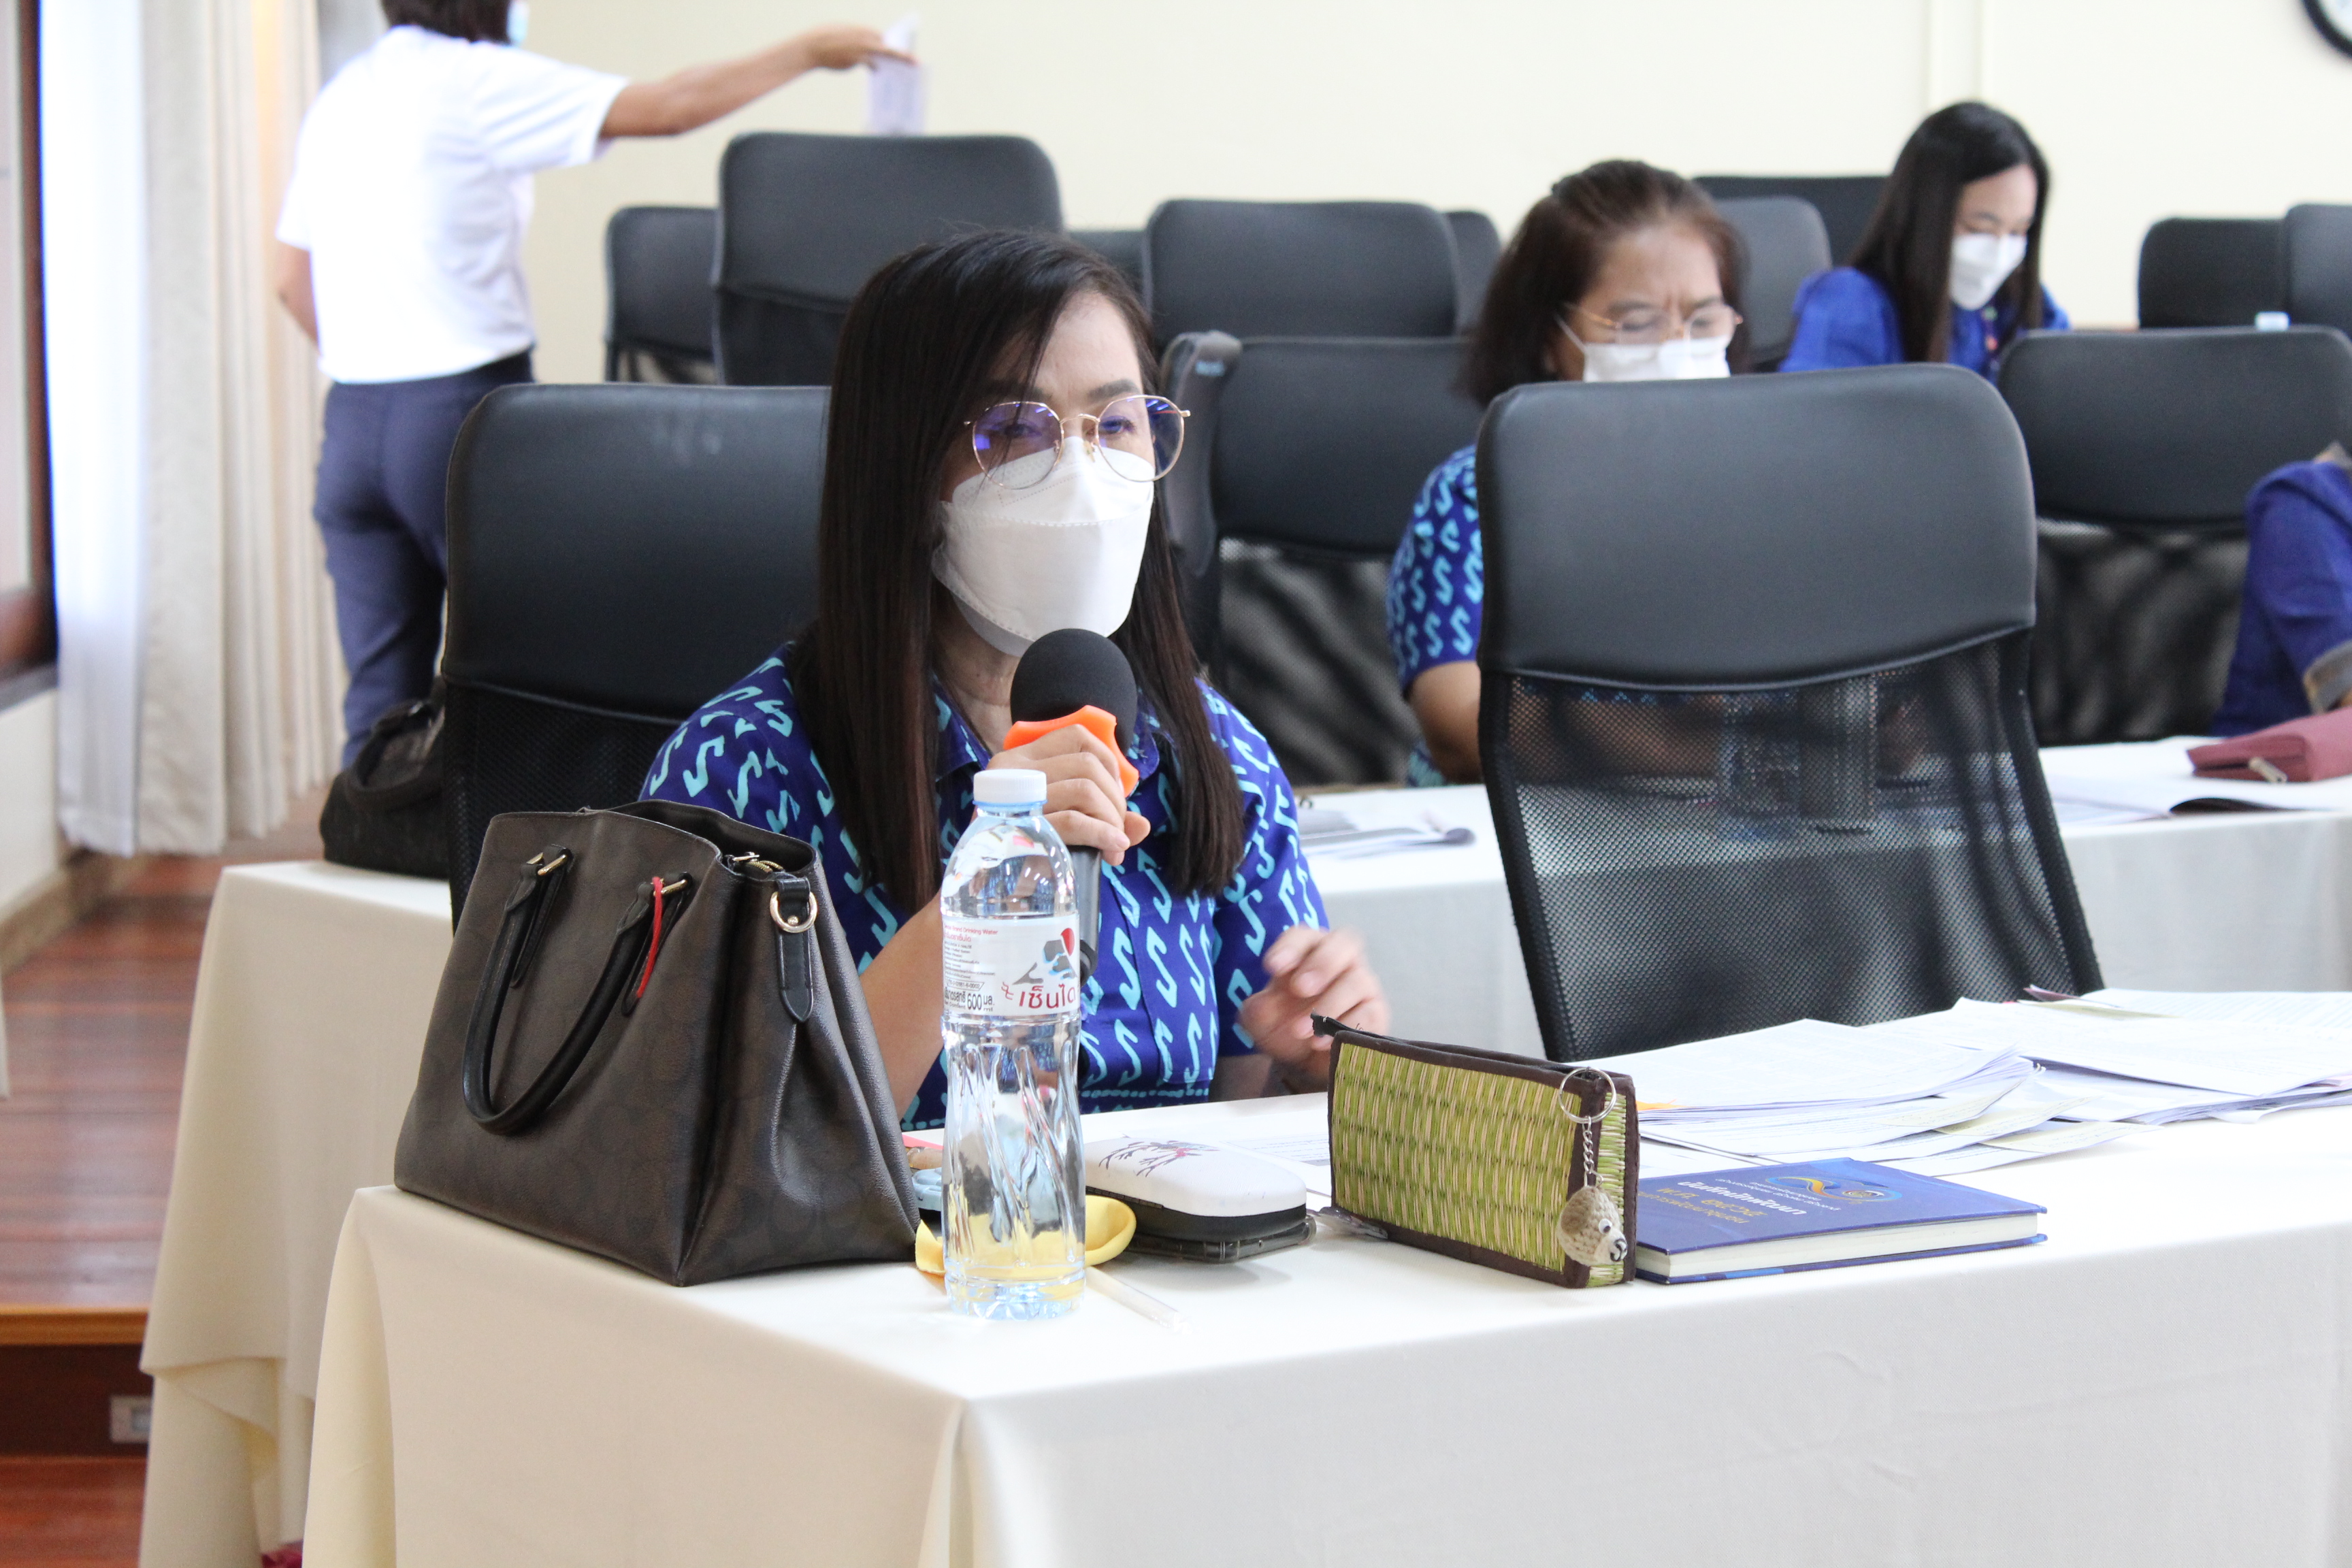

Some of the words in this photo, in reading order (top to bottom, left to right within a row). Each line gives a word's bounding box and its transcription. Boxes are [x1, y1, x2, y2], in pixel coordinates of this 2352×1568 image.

[963, 928, 981, 936] Drinking
[967, 993, 982, 1011] 600
[1678, 1181, 1808, 1215] บันทึกนักพัฒนา
